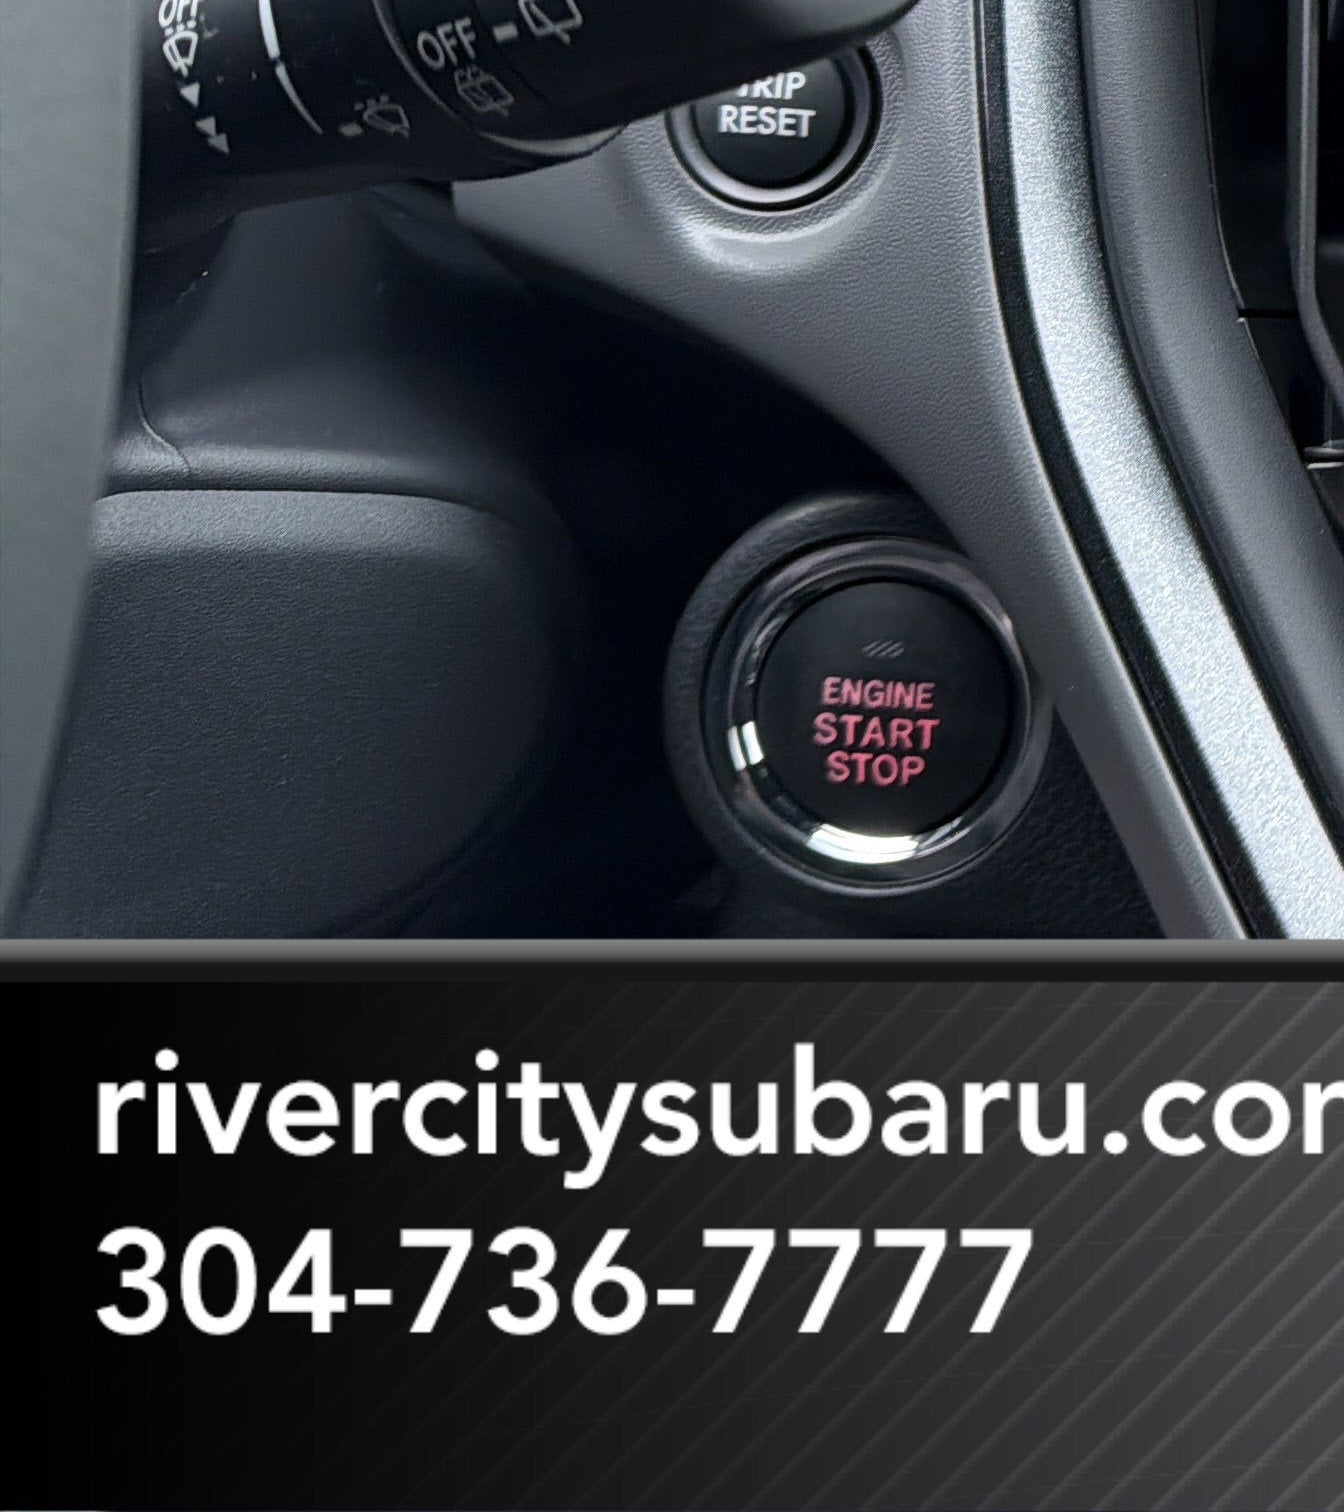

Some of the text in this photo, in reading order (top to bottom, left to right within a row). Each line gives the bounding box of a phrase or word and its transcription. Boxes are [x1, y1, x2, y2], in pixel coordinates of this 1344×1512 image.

[416, 16, 477, 70] OFF
[717, 103, 817, 138] RESET
[821, 676, 936, 711] ENGINE
[812, 712, 941, 751] START
[826, 750, 925, 785] STOP
